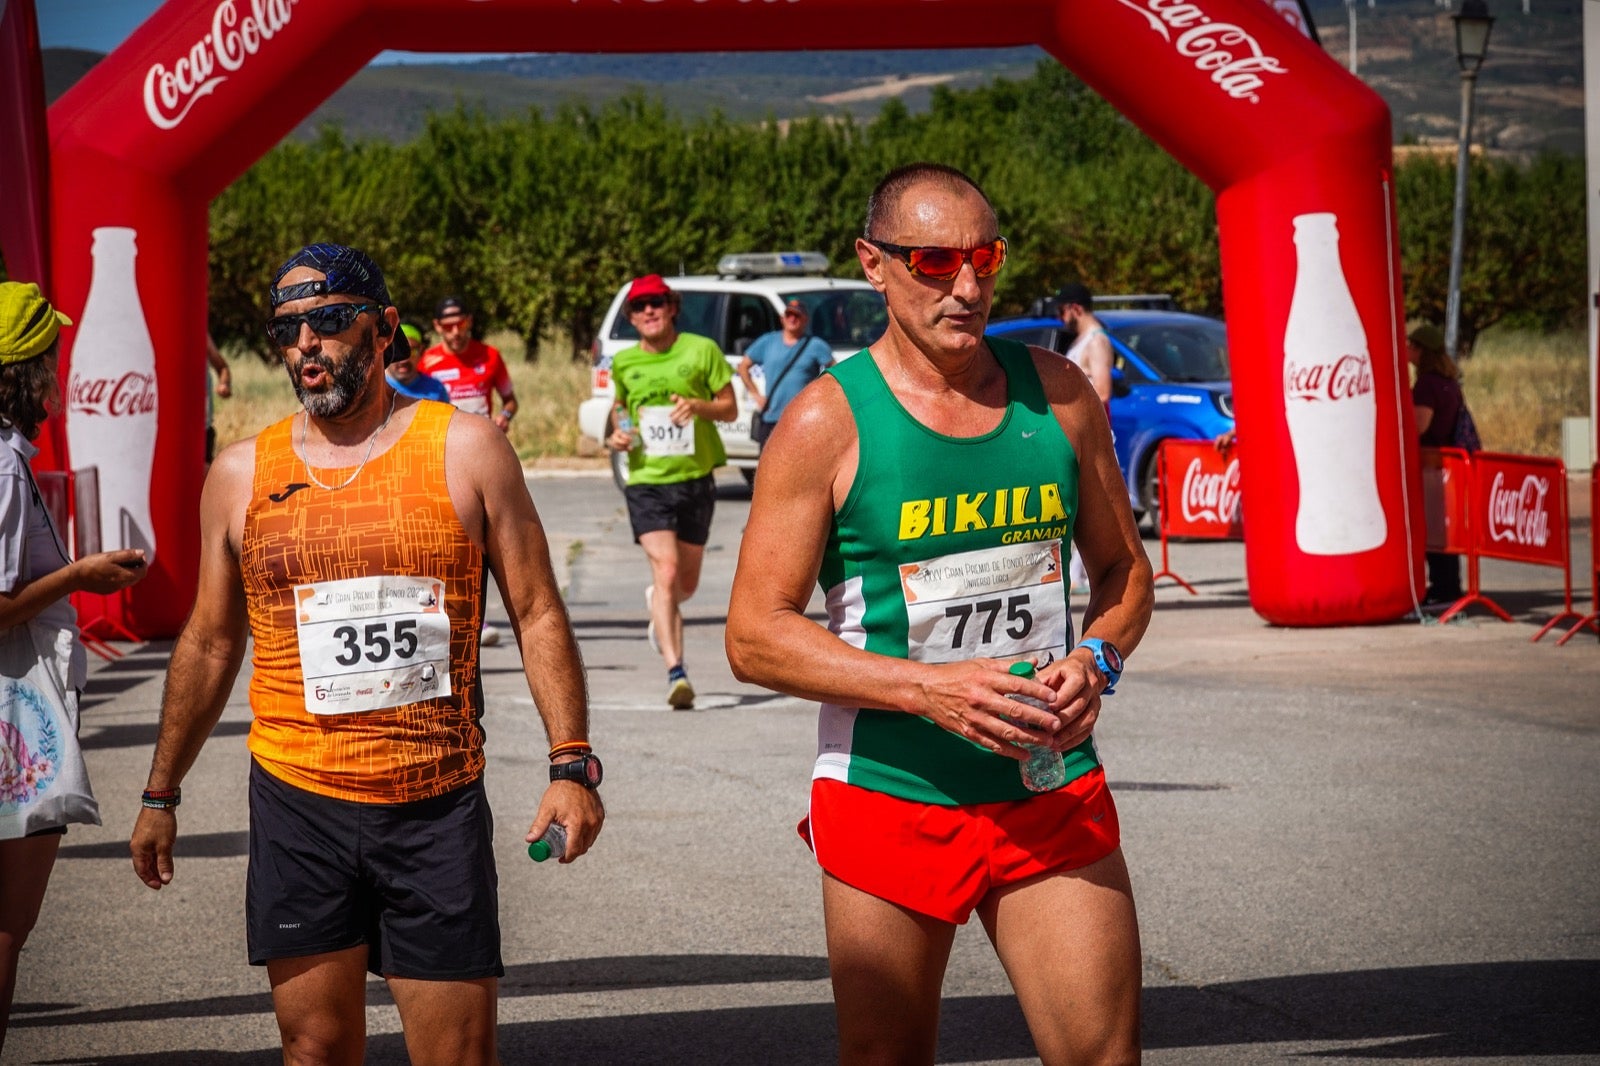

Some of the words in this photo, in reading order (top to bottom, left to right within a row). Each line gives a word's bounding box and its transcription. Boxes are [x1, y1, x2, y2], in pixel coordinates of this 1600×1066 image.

[143, 0, 300, 130] Coca-Cola
[1117, 0, 1290, 104] ca-Cola
[69, 371, 155, 417] Coca-Cola
[1287, 354, 1371, 402] Coca-Cola
[649, 425, 683, 440] 3017
[898, 483, 1068, 540] BIKILA
[1488, 471, 1551, 547] Coca-Cola
[1001, 525, 1067, 545] GRANADA
[333, 619, 418, 666] 355
[945, 594, 1033, 649] 775
